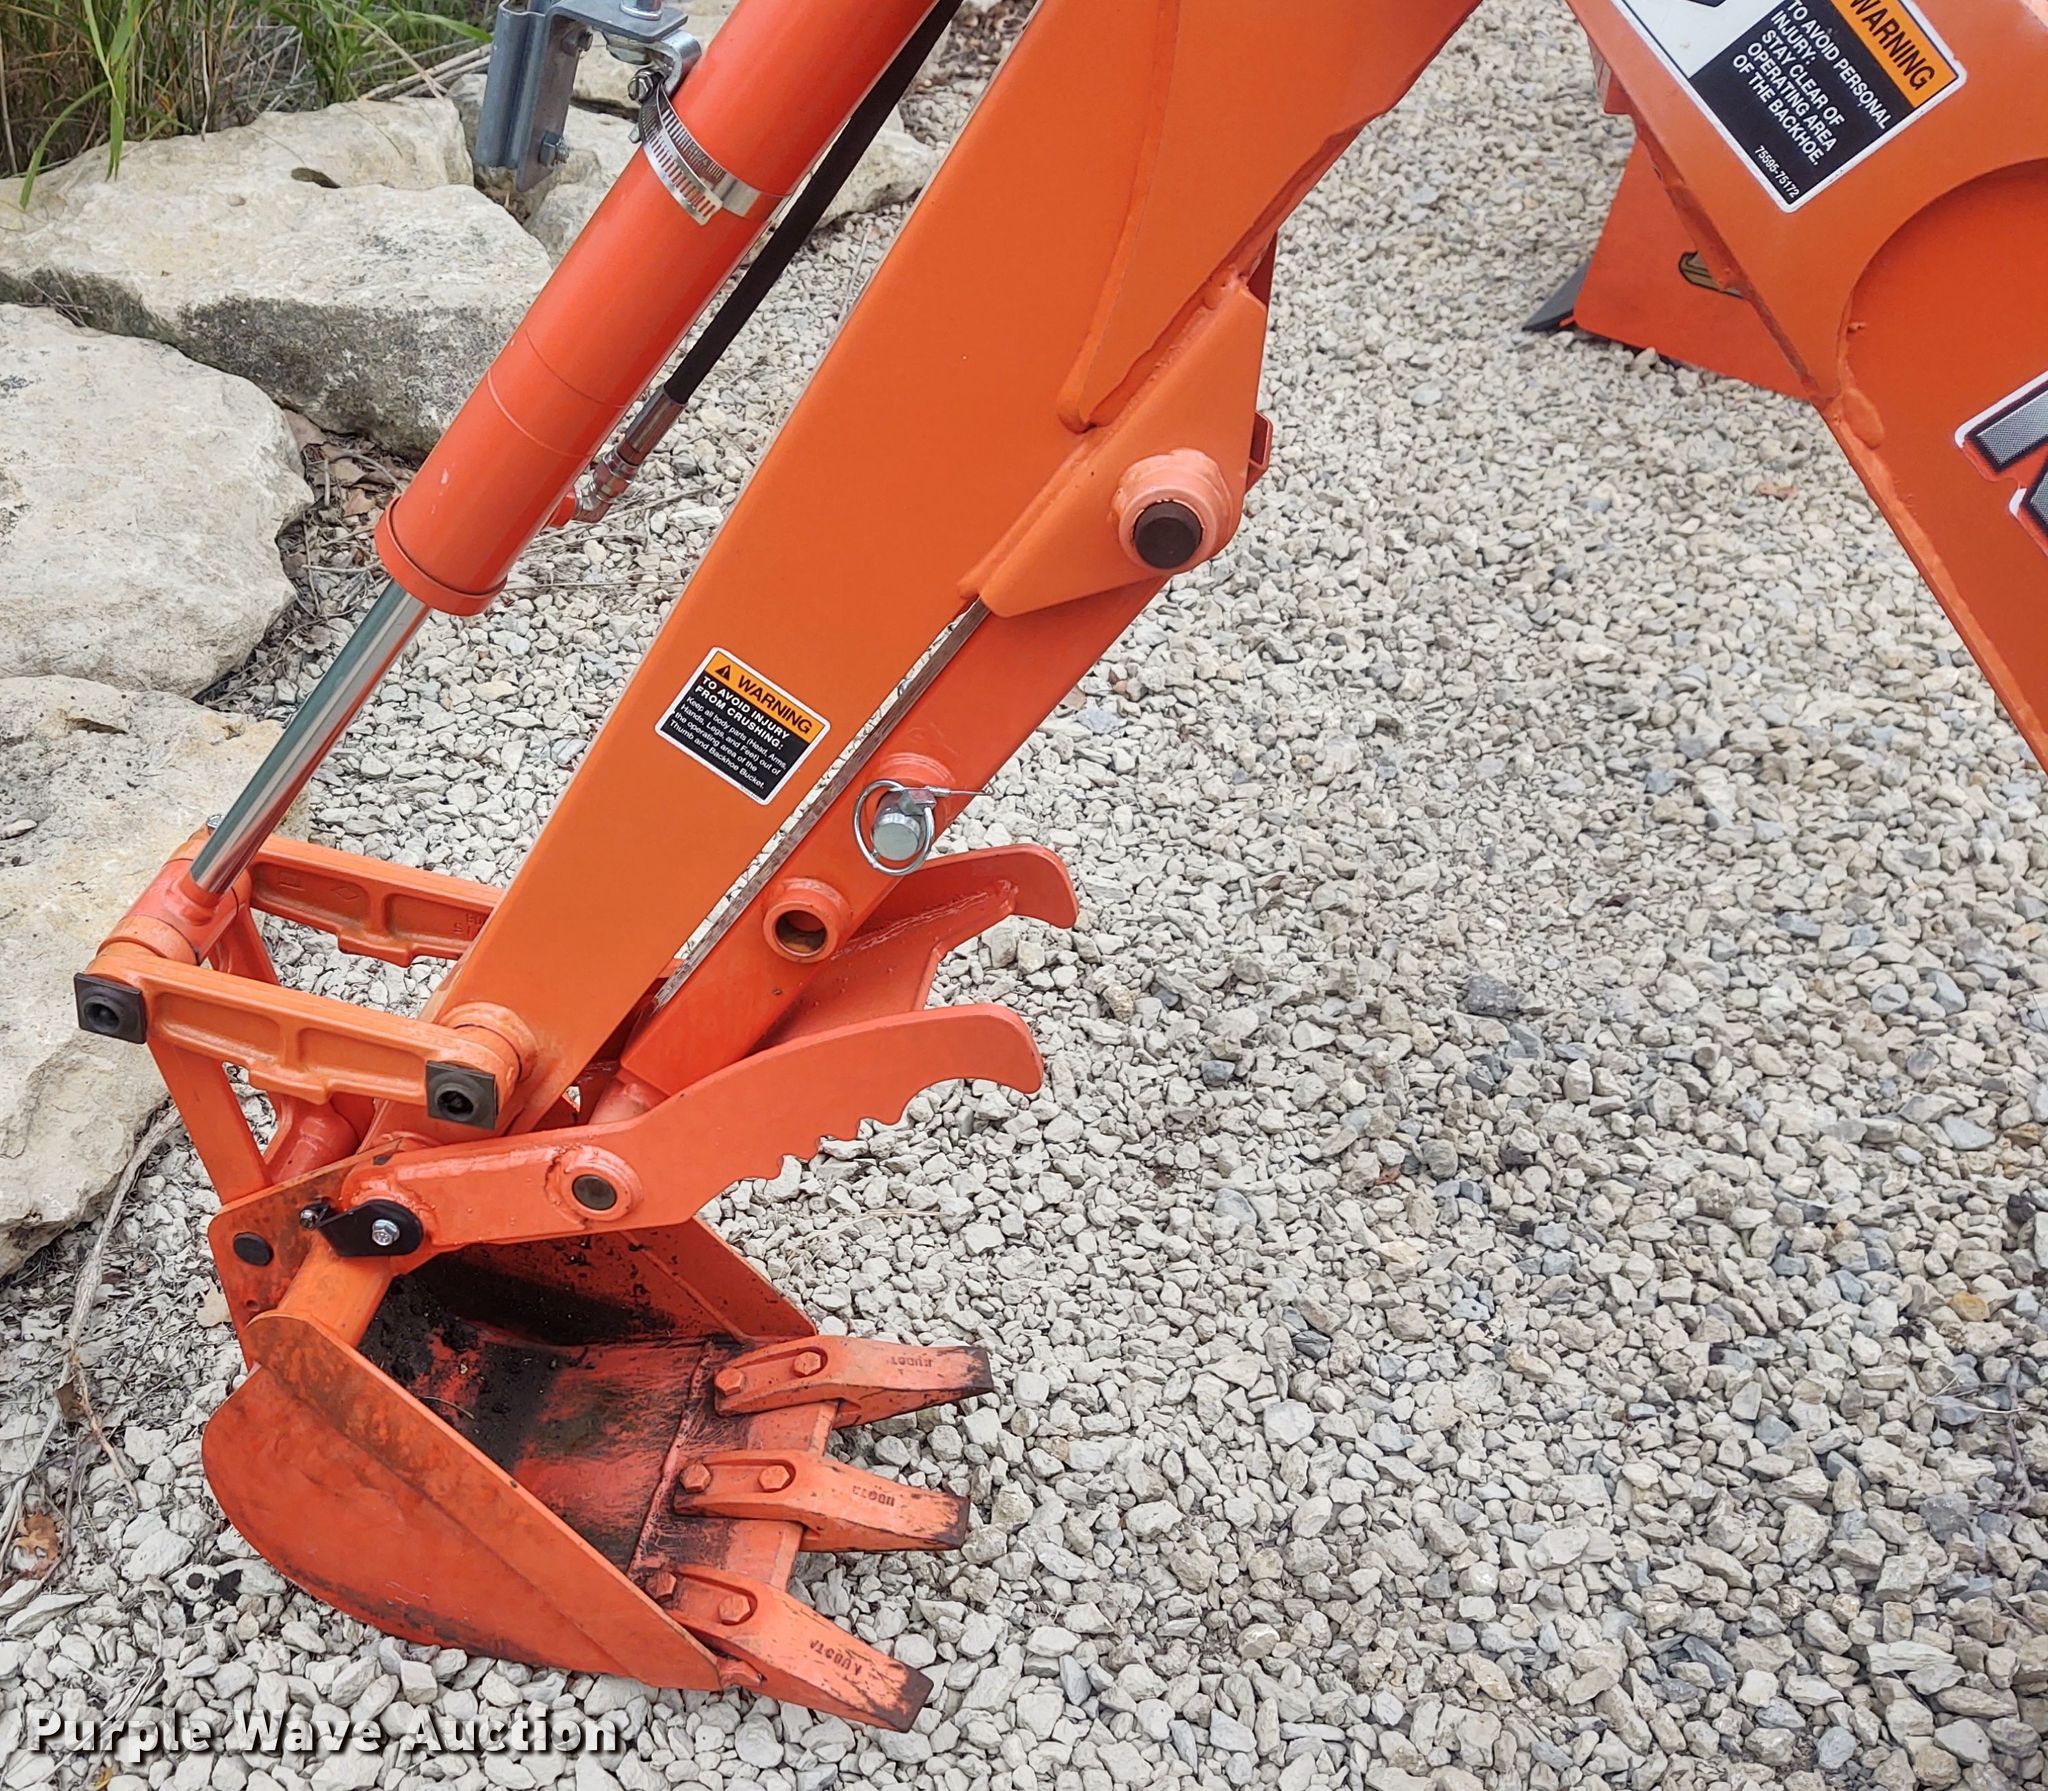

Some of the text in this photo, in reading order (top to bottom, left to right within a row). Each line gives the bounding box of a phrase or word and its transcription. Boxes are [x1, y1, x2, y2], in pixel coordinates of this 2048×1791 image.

[1771, 9, 1815, 65] INJURY:
[1788, 0, 1895, 130] TO AVOID PERSONAL
[1850, 0, 1936, 91] WARNING
[1732, 54, 1825, 166] OF THE BACKHOE.
[1747, 42, 1838, 153] OPERATING AREA
[1761, 29, 1846, 128] STAY CLEAR OF
[1754, 145, 1799, 199] 75595-75172
[680, 703, 782, 776] Hands, Legs, and Feet) out of
[686, 696, 787, 770] Keep all body parts (Head, Arms,
[694, 685, 784, 750] FROM CRUSHING:
[702, 675, 791, 740] TO AVOID INJURY
[737, 674, 813, 735] WARNING
[669, 719, 765, 789] Thumb and Backhoe Bucket.
[674, 711, 758, 772] the operating area of the
